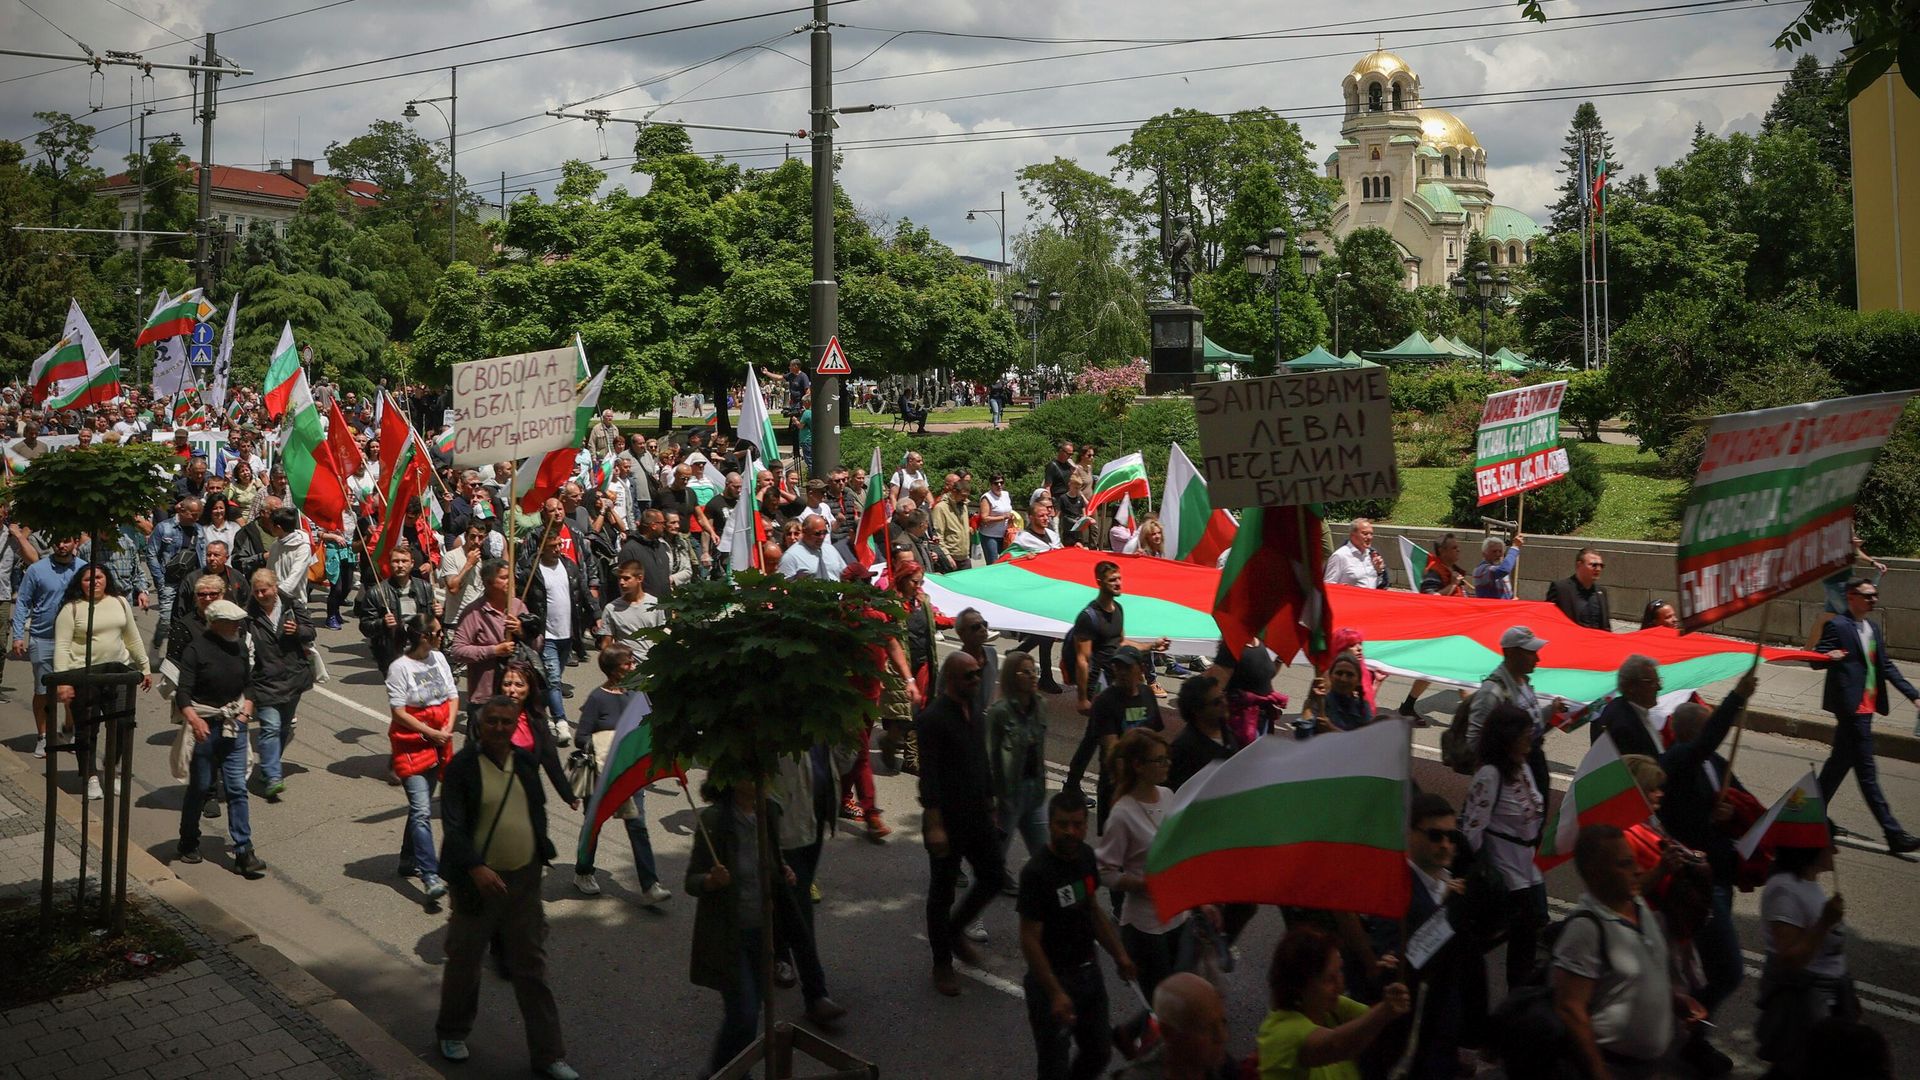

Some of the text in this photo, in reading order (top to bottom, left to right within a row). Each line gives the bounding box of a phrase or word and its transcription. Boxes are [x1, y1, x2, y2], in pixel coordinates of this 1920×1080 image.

[457, 354, 559, 396] СВОБОДА
[1194, 372, 1387, 415] ЗАПАЗВАМЕ
[454, 407, 471, 422] ЗА
[1250, 409, 1366, 449] ЛЕВА!
[454, 422, 514, 455] СМЪРТ
[1255, 464, 1399, 506] БИТКАТА!
